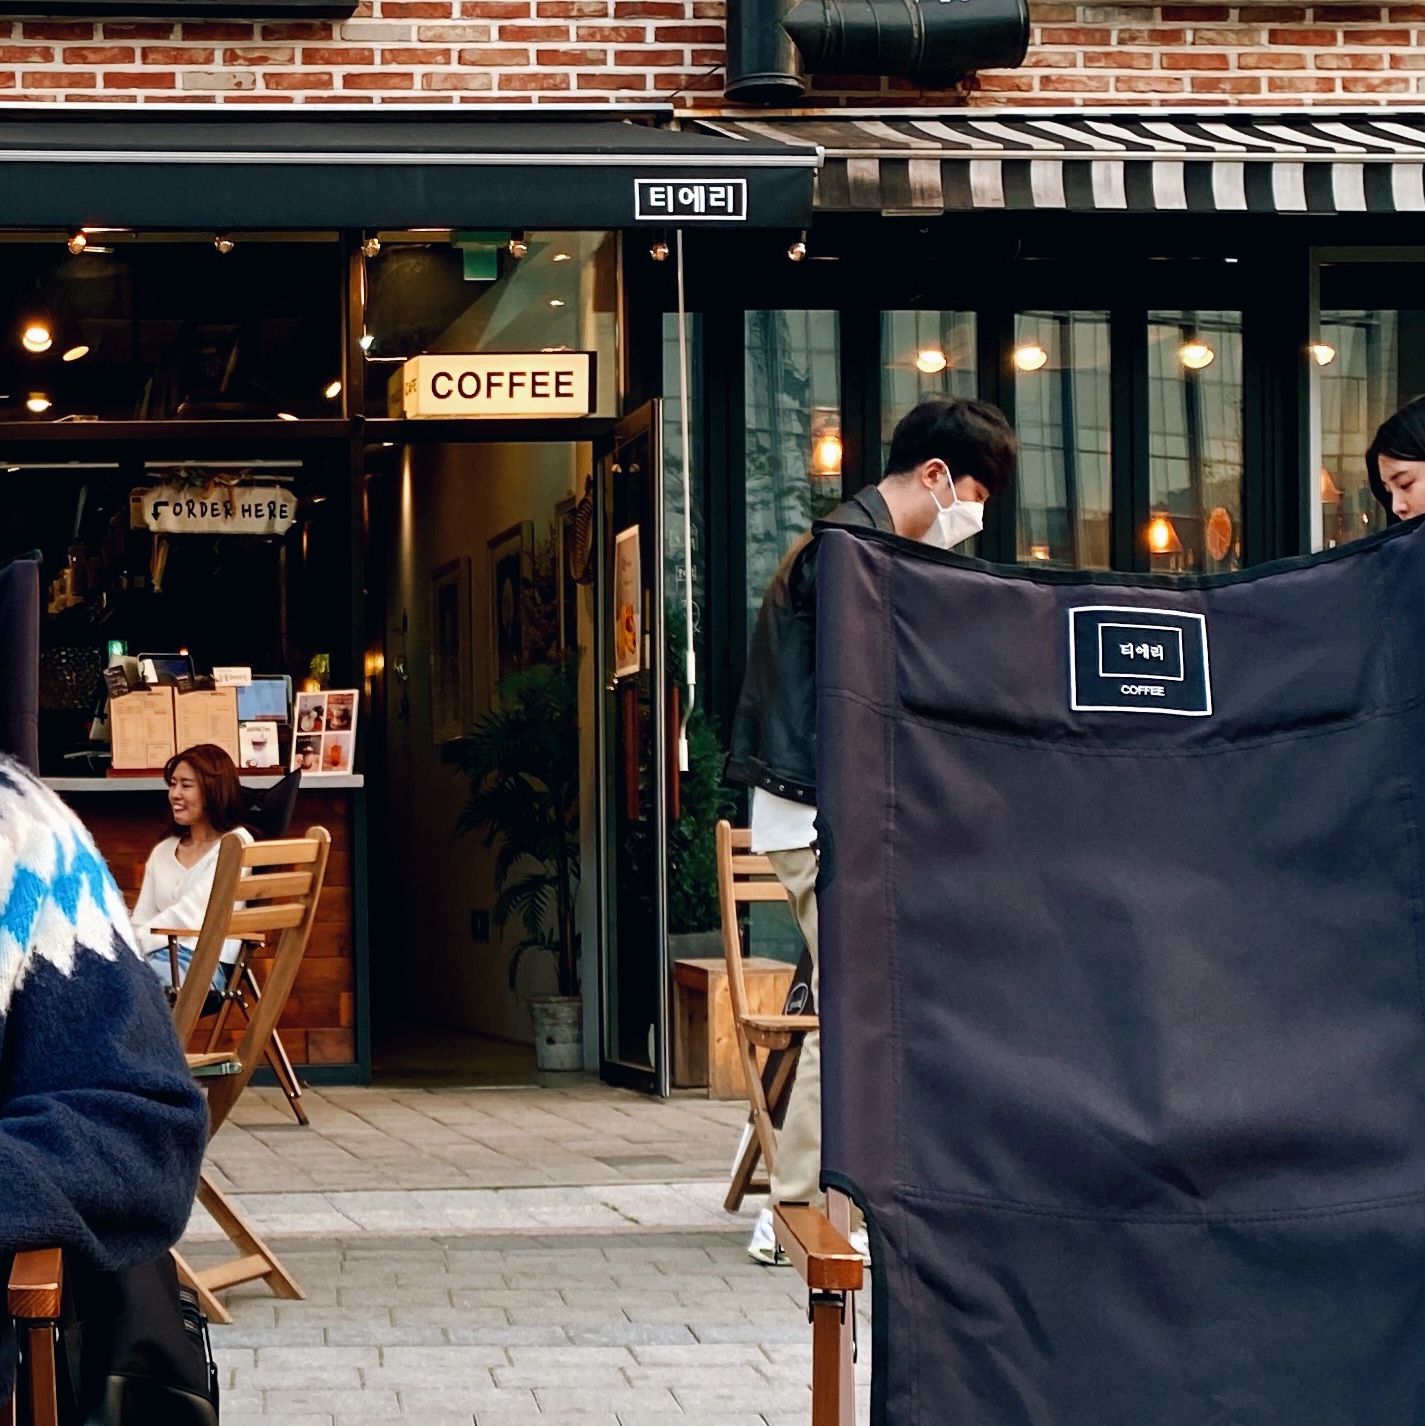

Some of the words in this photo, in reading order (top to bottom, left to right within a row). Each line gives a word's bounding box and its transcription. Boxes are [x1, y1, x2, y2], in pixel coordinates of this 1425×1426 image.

[649, 185, 734, 213] 티에리
[430, 371, 575, 400] COFFEE
[172, 499, 234, 519] ORDER
[241, 500, 289, 520] HERE
[1119, 642, 1164, 661] 티에리
[1120, 684, 1166, 697] COFFEE
